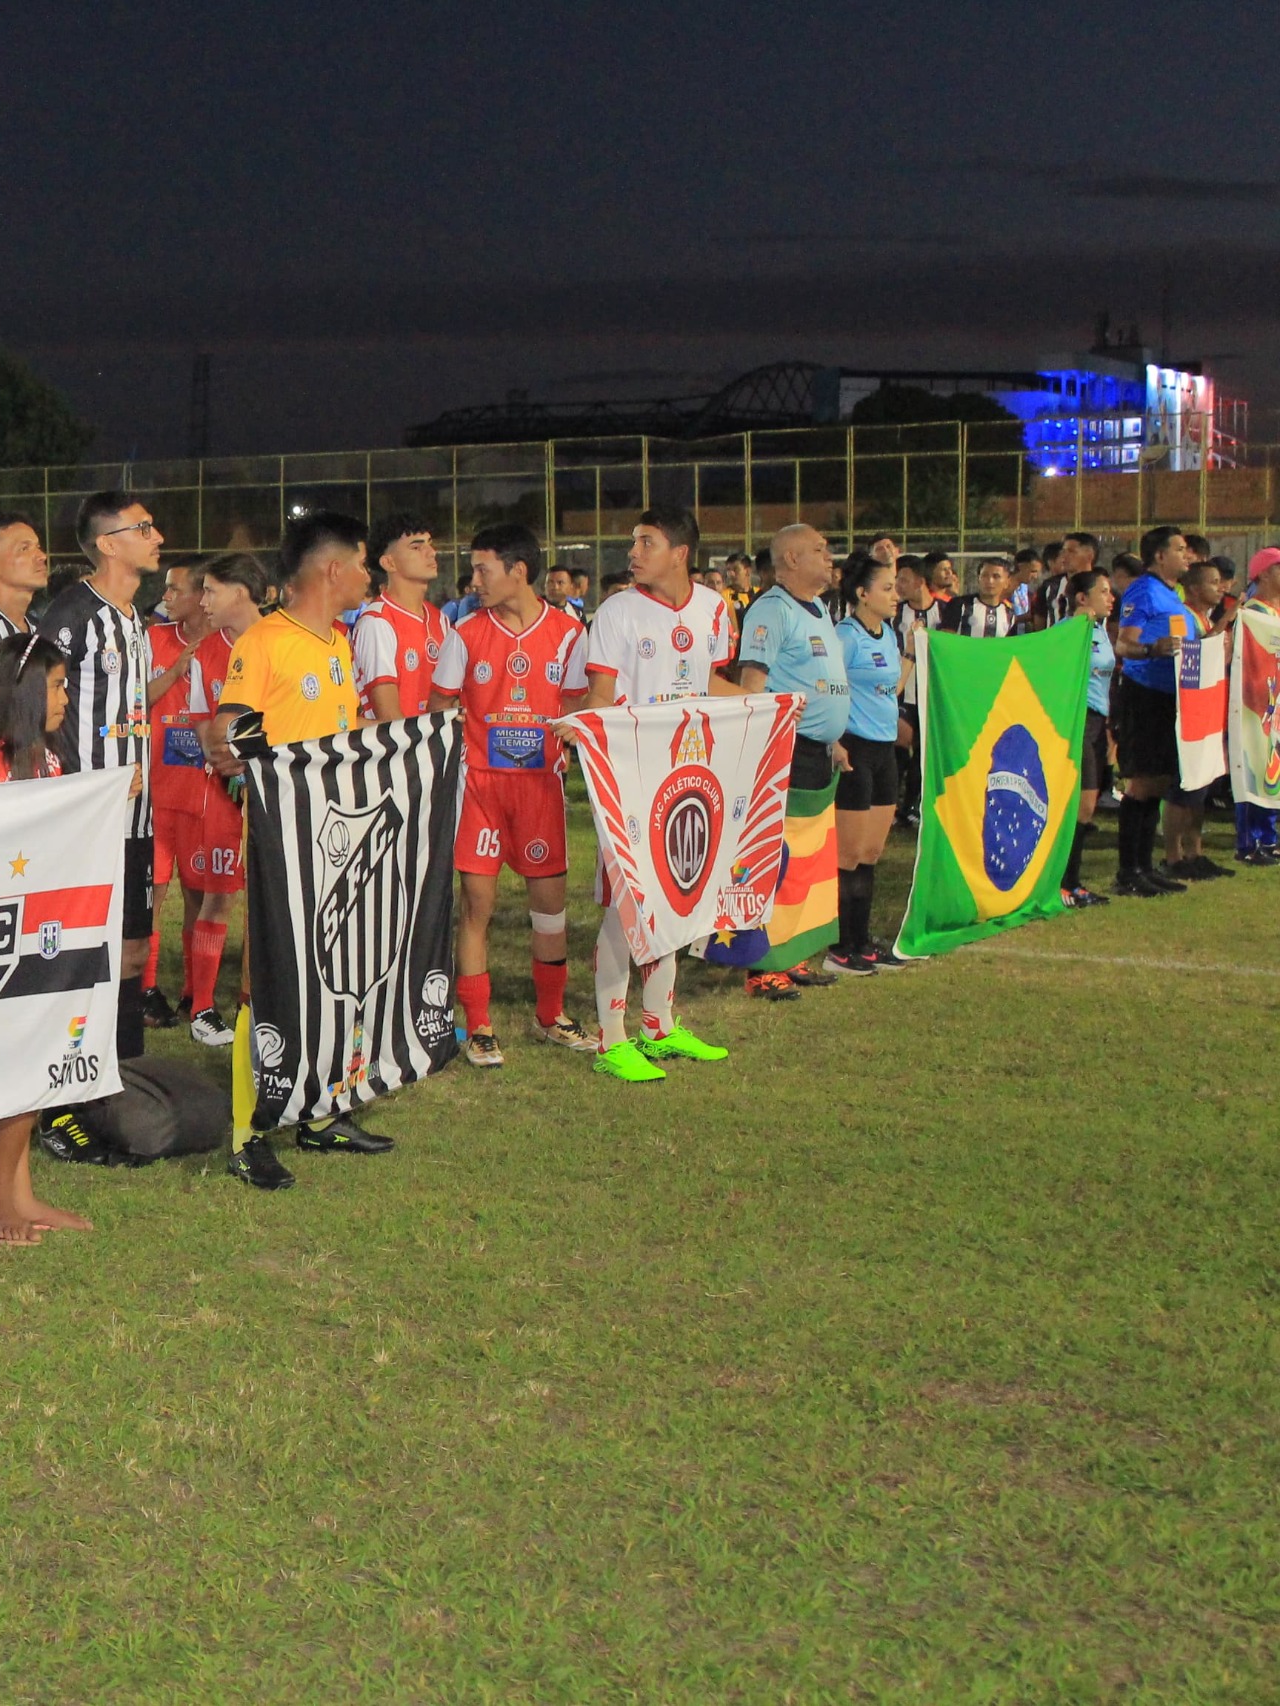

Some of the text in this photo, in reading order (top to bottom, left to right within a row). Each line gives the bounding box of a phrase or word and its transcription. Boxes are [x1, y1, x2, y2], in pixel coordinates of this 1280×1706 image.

[496, 730, 538, 738] MICHAEL
[654, 776, 721, 830] JAC ATLÉTICO CLUBE
[476, 828, 500, 858] 05
[672, 810, 704, 880] JAC
[212, 847, 235, 876] 02
[717, 893, 765, 917] SANTOS
[48, 1054, 99, 1089] SANOS
